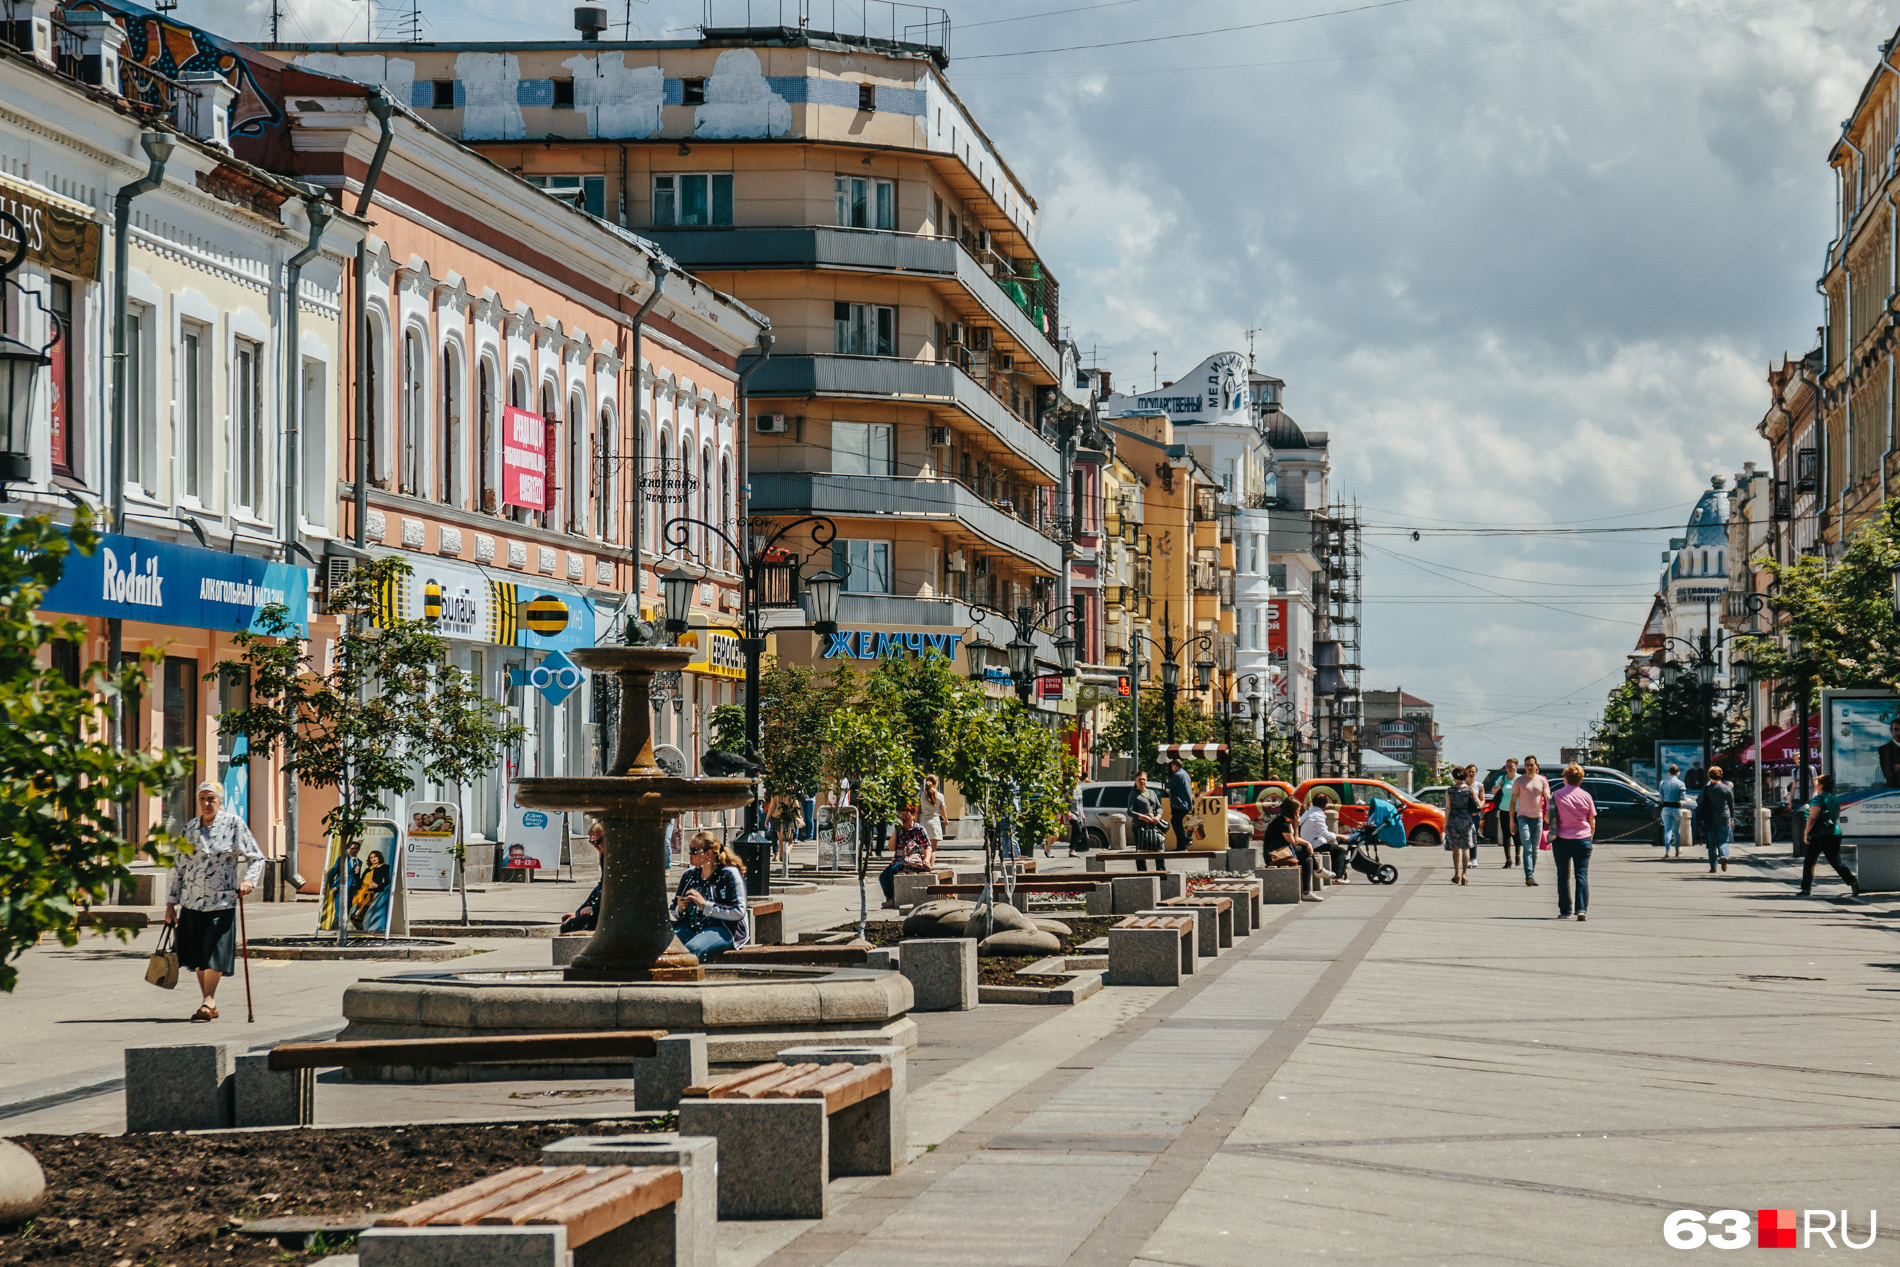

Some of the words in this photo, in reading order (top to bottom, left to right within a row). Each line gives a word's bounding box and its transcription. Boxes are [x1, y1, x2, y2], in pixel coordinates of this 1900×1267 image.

[103, 547, 163, 606] Rodnik
[200, 577, 253, 606] АЛКОГОЛЬНЫЙ
[254, 586, 284, 608] МАГАЗИН
[824, 630, 964, 662] ЖЕМЧУГ
[1118, 686, 1130, 695] 43
